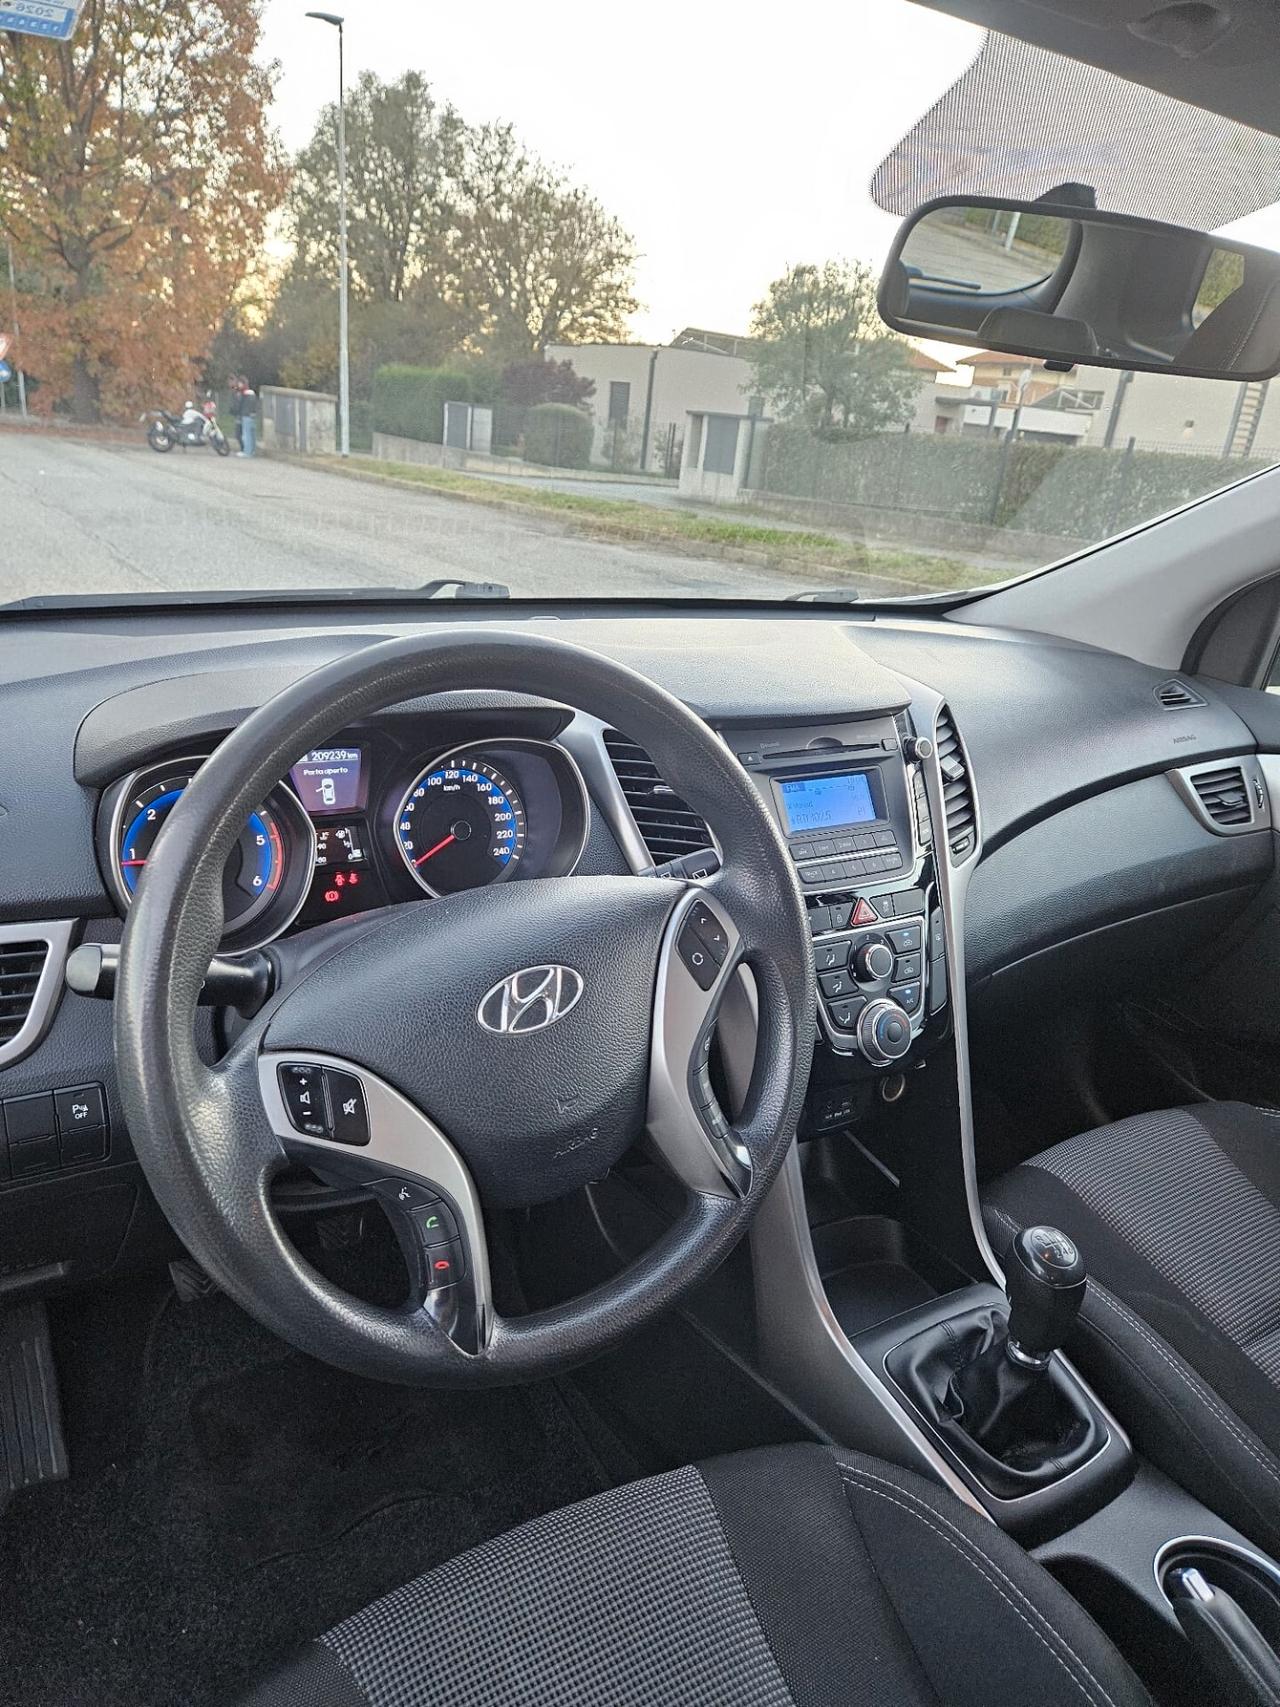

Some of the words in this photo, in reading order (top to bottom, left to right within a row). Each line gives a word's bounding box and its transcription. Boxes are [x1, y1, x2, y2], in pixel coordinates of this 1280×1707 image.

[311, 750, 346, 761] 209239
[445, 770, 460, 779] 120
[462, 774, 478, 783] 140
[427, 777, 442, 786] 100
[477, 783, 492, 791] 160
[488, 796, 504, 805] 180
[147, 809, 156, 820] 2
[495, 812, 512, 821] 200
[400, 822, 411, 830] 40
[496, 830, 513, 839] 220
[256, 835, 265, 846] 5
[129, 848, 136, 859] 1
[493, 846, 510, 856] 240
[252, 875, 262, 886] 6
[74, 1111, 88, 1120] OFF
